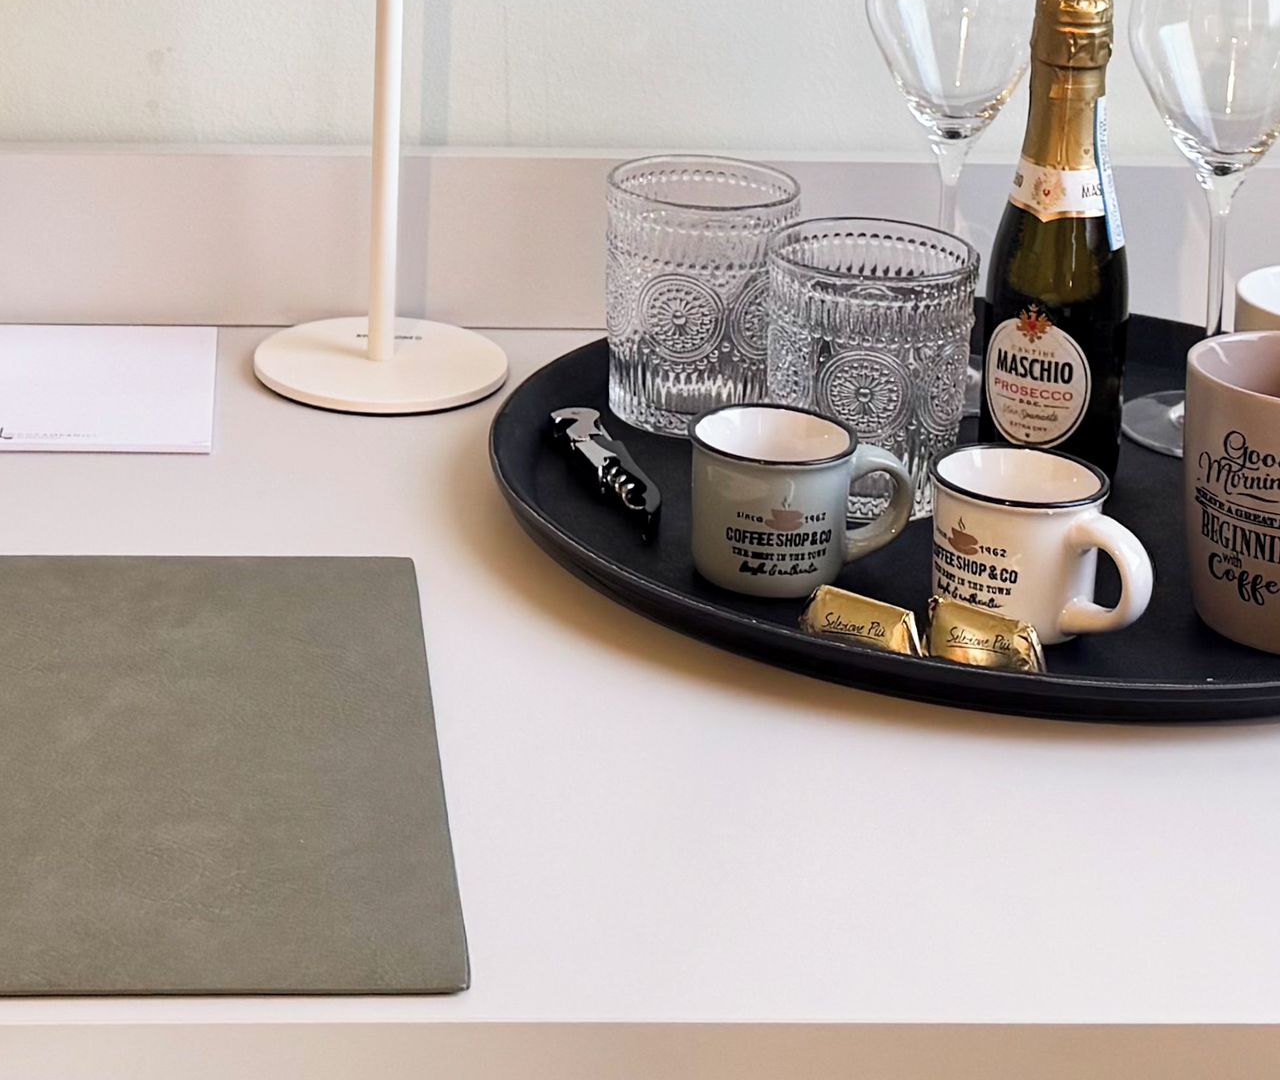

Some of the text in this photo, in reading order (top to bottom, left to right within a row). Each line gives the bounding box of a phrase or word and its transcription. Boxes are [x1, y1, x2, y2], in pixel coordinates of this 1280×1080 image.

[996, 347, 1074, 385] MASCHIO
[994, 377, 1074, 402] PROSECCO
[804, 511, 827, 523] 1962
[1235, 507, 1278, 527] GREAT
[776, 553, 787, 562] IN
[789, 552, 806, 561] THE
[807, 547, 827, 560] TOWN
[979, 545, 1008, 558] 1962
[1222, 551, 1242, 569] with
[955, 554, 987, 577] SHOP
[988, 564, 999, 581] &
[1000, 568, 1019, 585] CO
[957, 576, 966, 586] IN
[967, 580, 984, 592] THE
[986, 585, 1012, 596] TOWN
